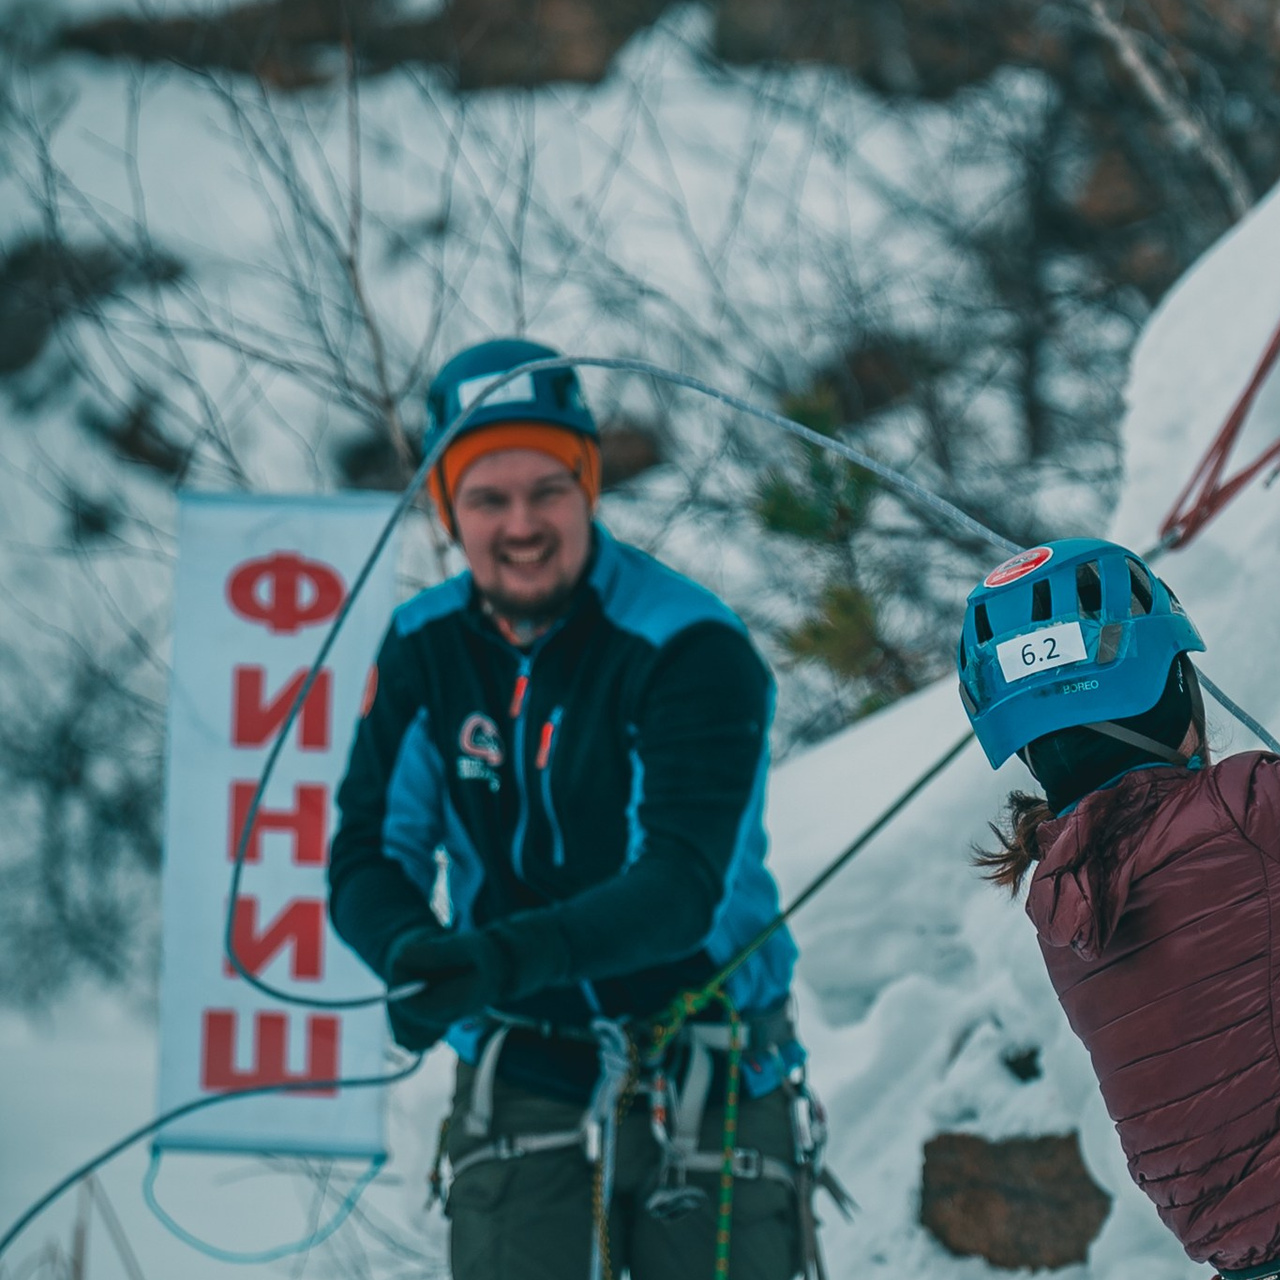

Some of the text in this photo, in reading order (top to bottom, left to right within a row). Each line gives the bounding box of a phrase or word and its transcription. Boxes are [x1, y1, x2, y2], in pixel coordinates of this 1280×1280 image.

[1021, 637, 1061, 666] 6.2
[1062, 679, 1099, 695] BOREO
[202, 551, 347, 1097] ФИНИШ
